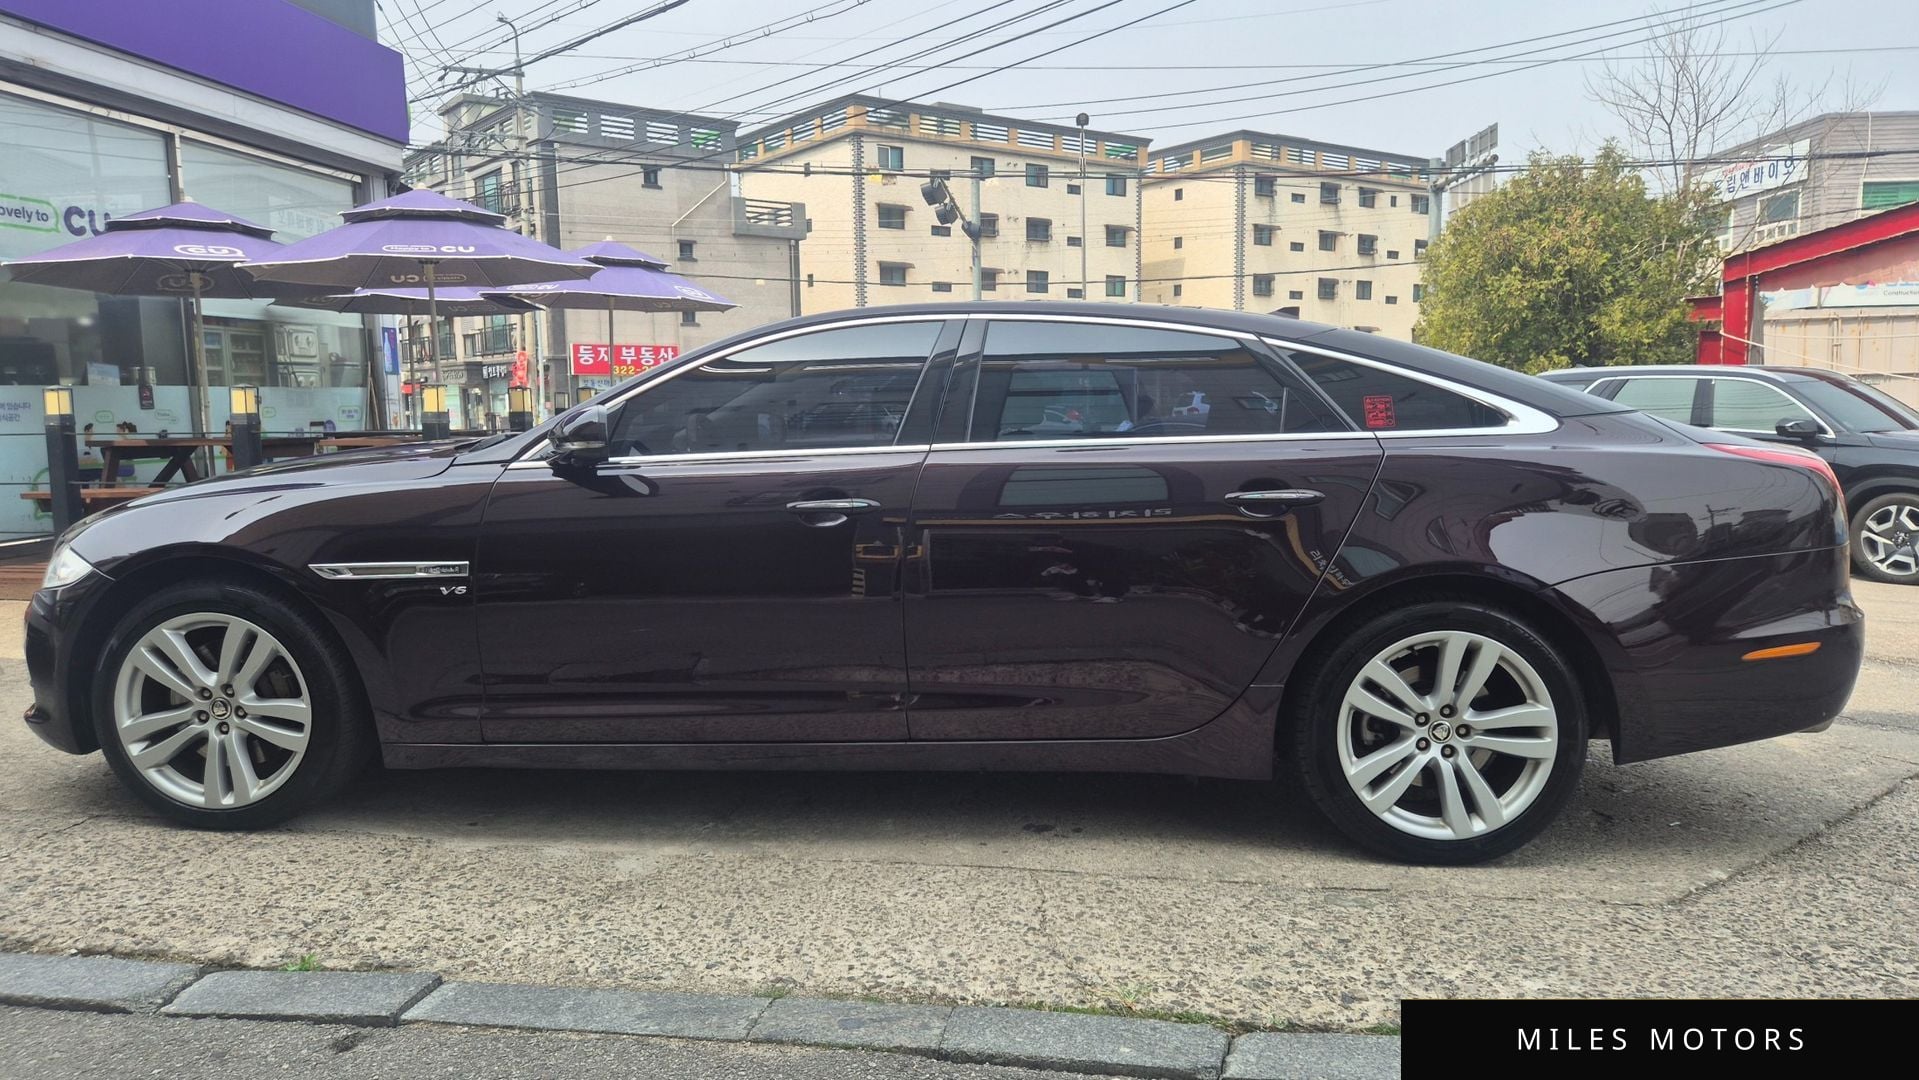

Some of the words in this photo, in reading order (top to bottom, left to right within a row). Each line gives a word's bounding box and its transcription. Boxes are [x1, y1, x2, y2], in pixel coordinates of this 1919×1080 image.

[36, 209, 49, 222] to
[63, 206, 111, 237] CU
[578, 345, 611, 365] 둥지
[620, 346, 674, 366] 부동산
[613, 365, 658, 375] 322-2
[440, 586, 467, 595] V6
